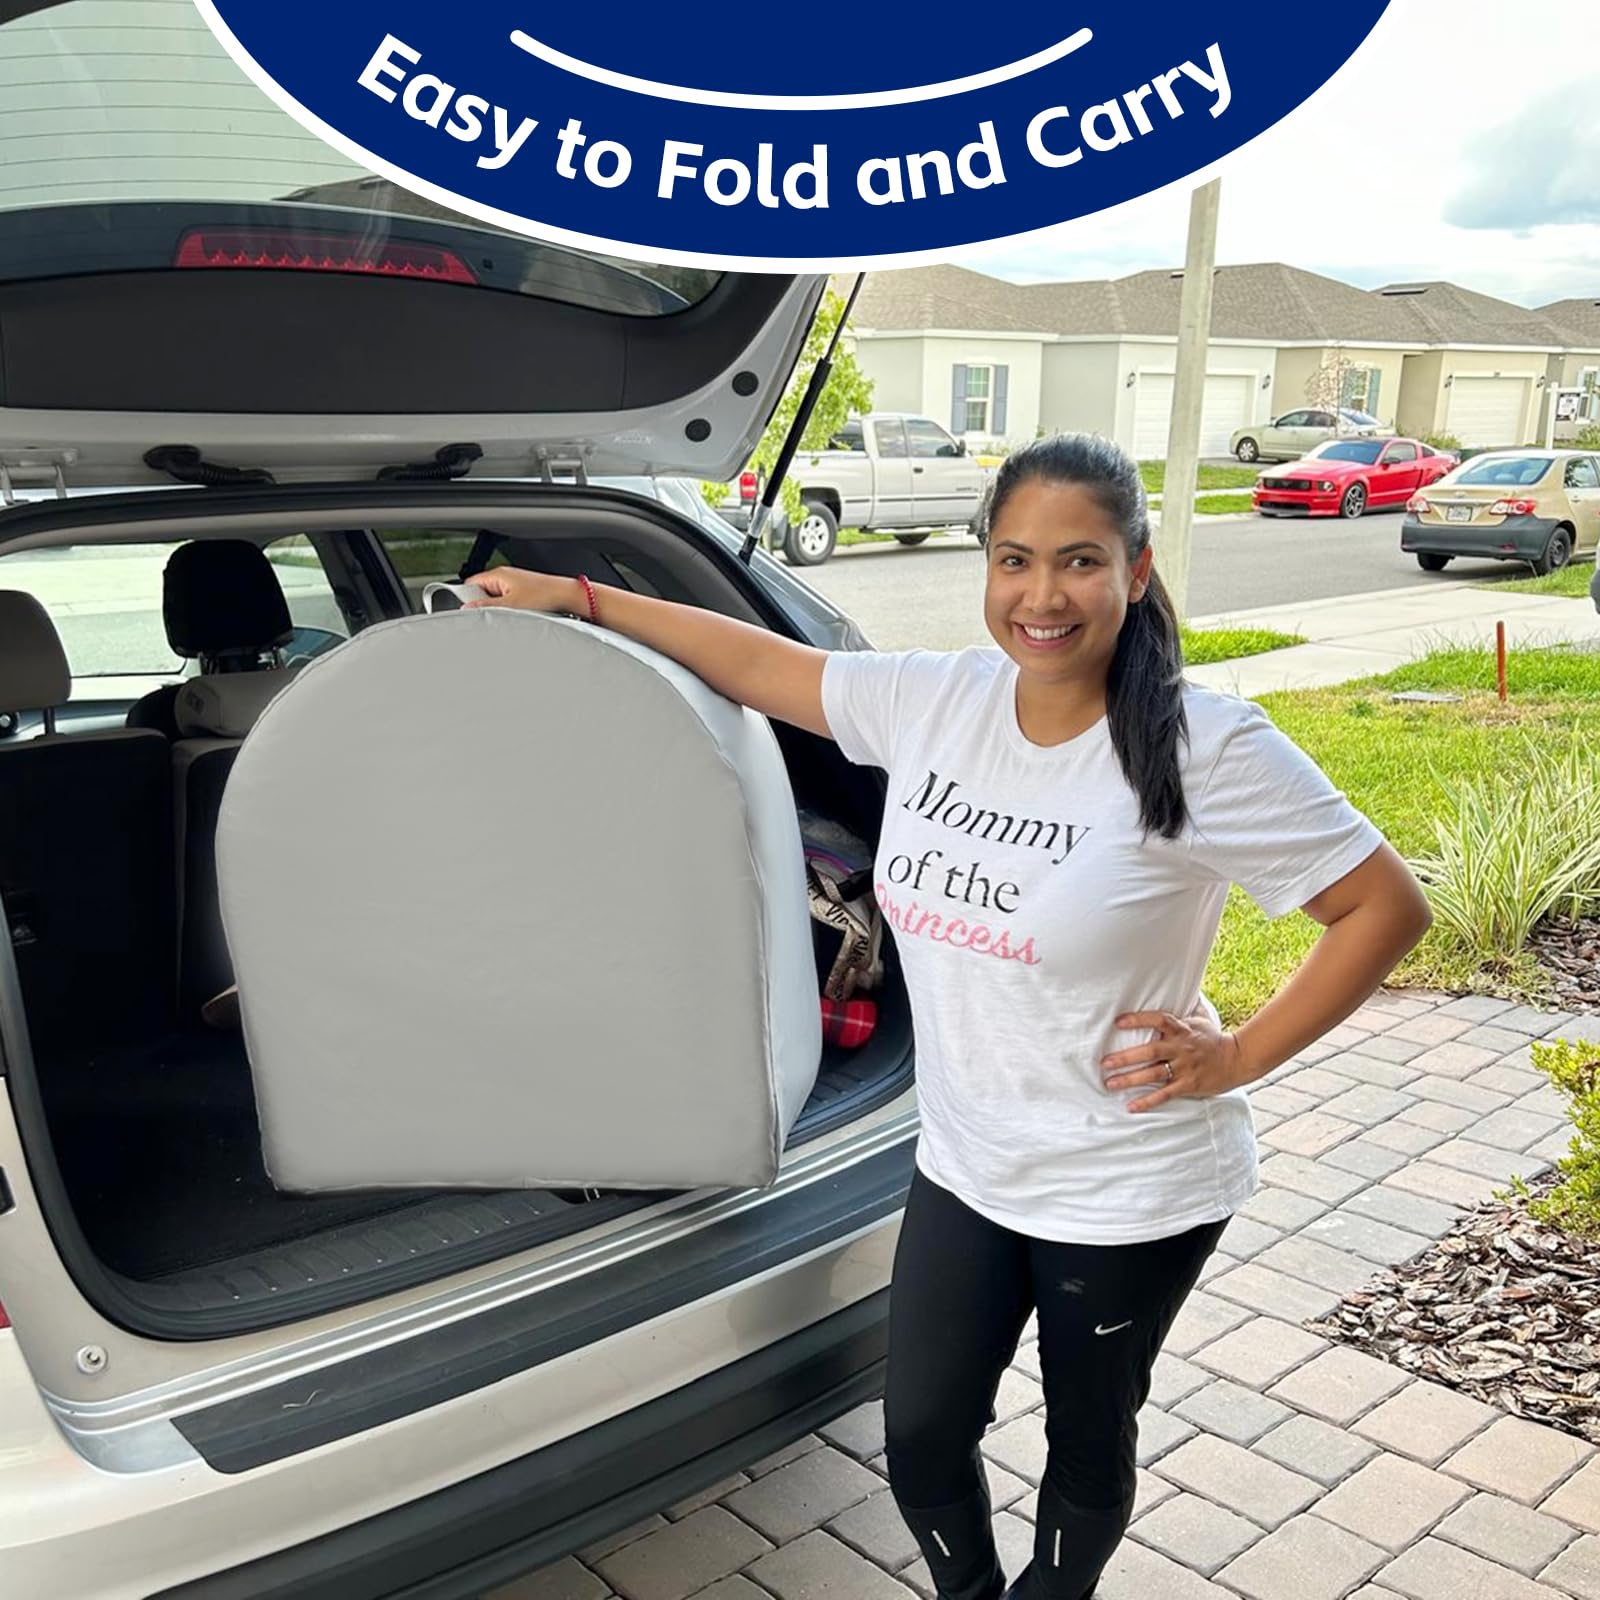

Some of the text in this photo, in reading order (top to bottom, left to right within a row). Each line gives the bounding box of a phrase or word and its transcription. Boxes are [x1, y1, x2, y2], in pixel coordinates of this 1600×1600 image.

[902, 769, 1092, 866] Mommy
[887, 849, 1020, 914] of the
